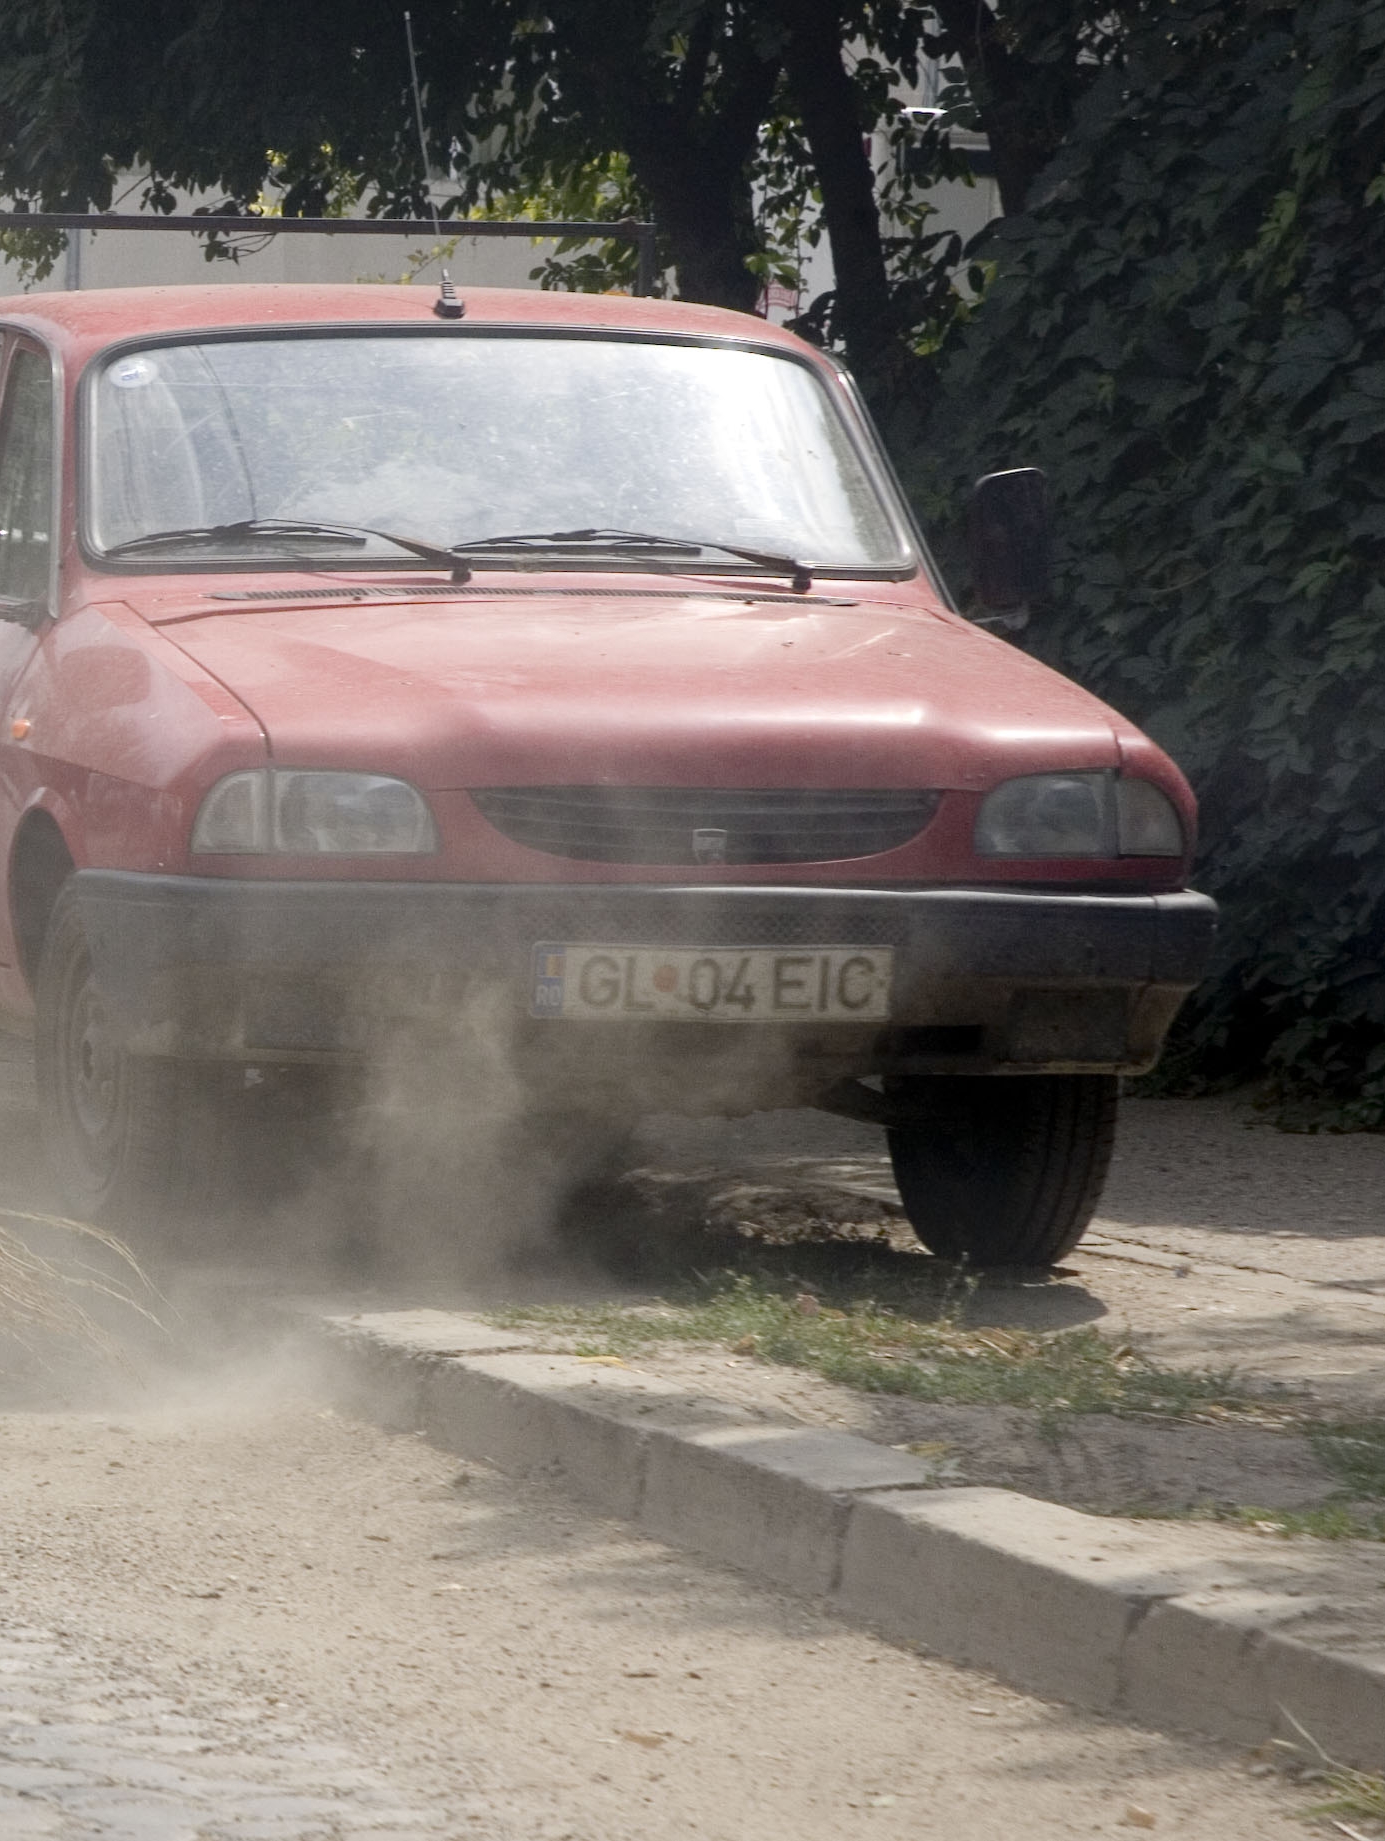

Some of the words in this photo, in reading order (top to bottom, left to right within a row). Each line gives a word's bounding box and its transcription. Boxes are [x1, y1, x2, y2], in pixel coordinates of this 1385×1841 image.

[579, 955, 657, 1012] GL
[687, 957, 757, 1012] 04
[773, 955, 877, 1010] EIC
